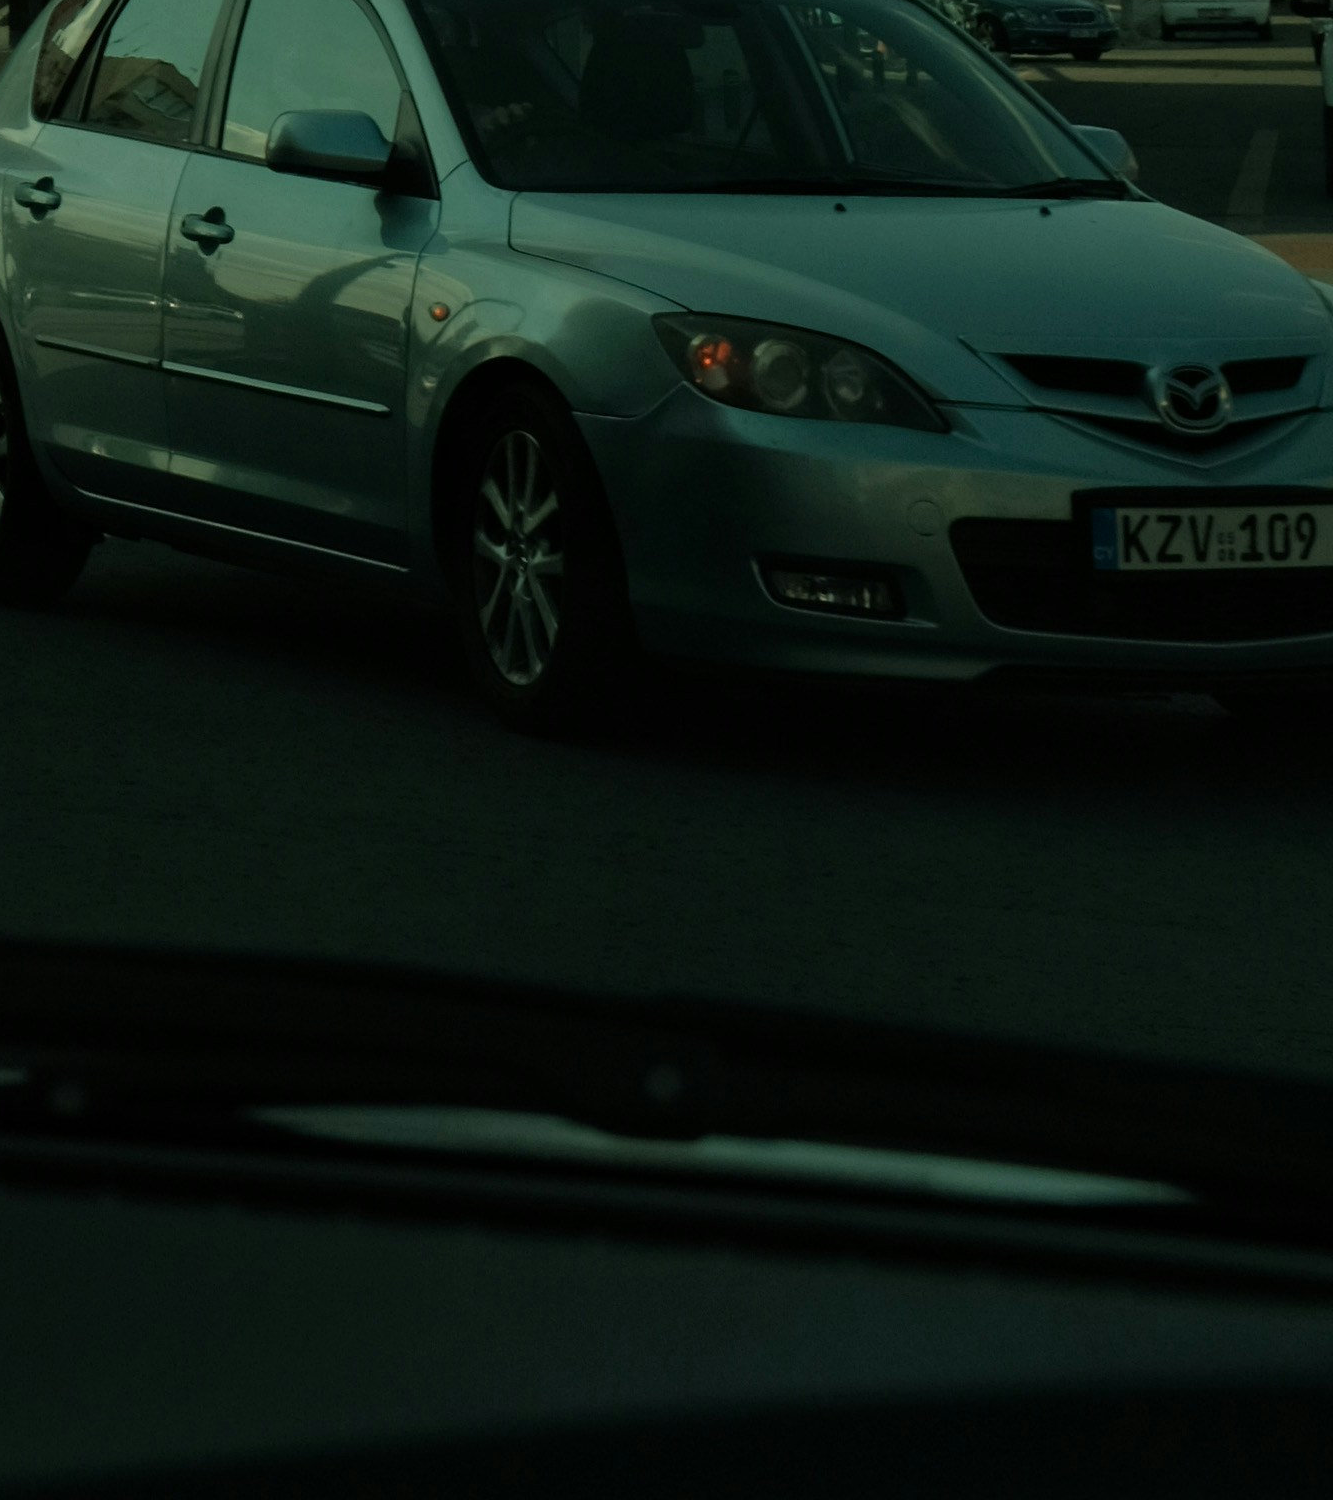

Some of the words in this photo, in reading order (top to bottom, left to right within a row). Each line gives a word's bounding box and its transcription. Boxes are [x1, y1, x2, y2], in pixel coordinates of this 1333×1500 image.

[1093, 545, 1115, 561] CY
[1123, 514, 1214, 563] KZV
[1239, 512, 1317, 562] 109
